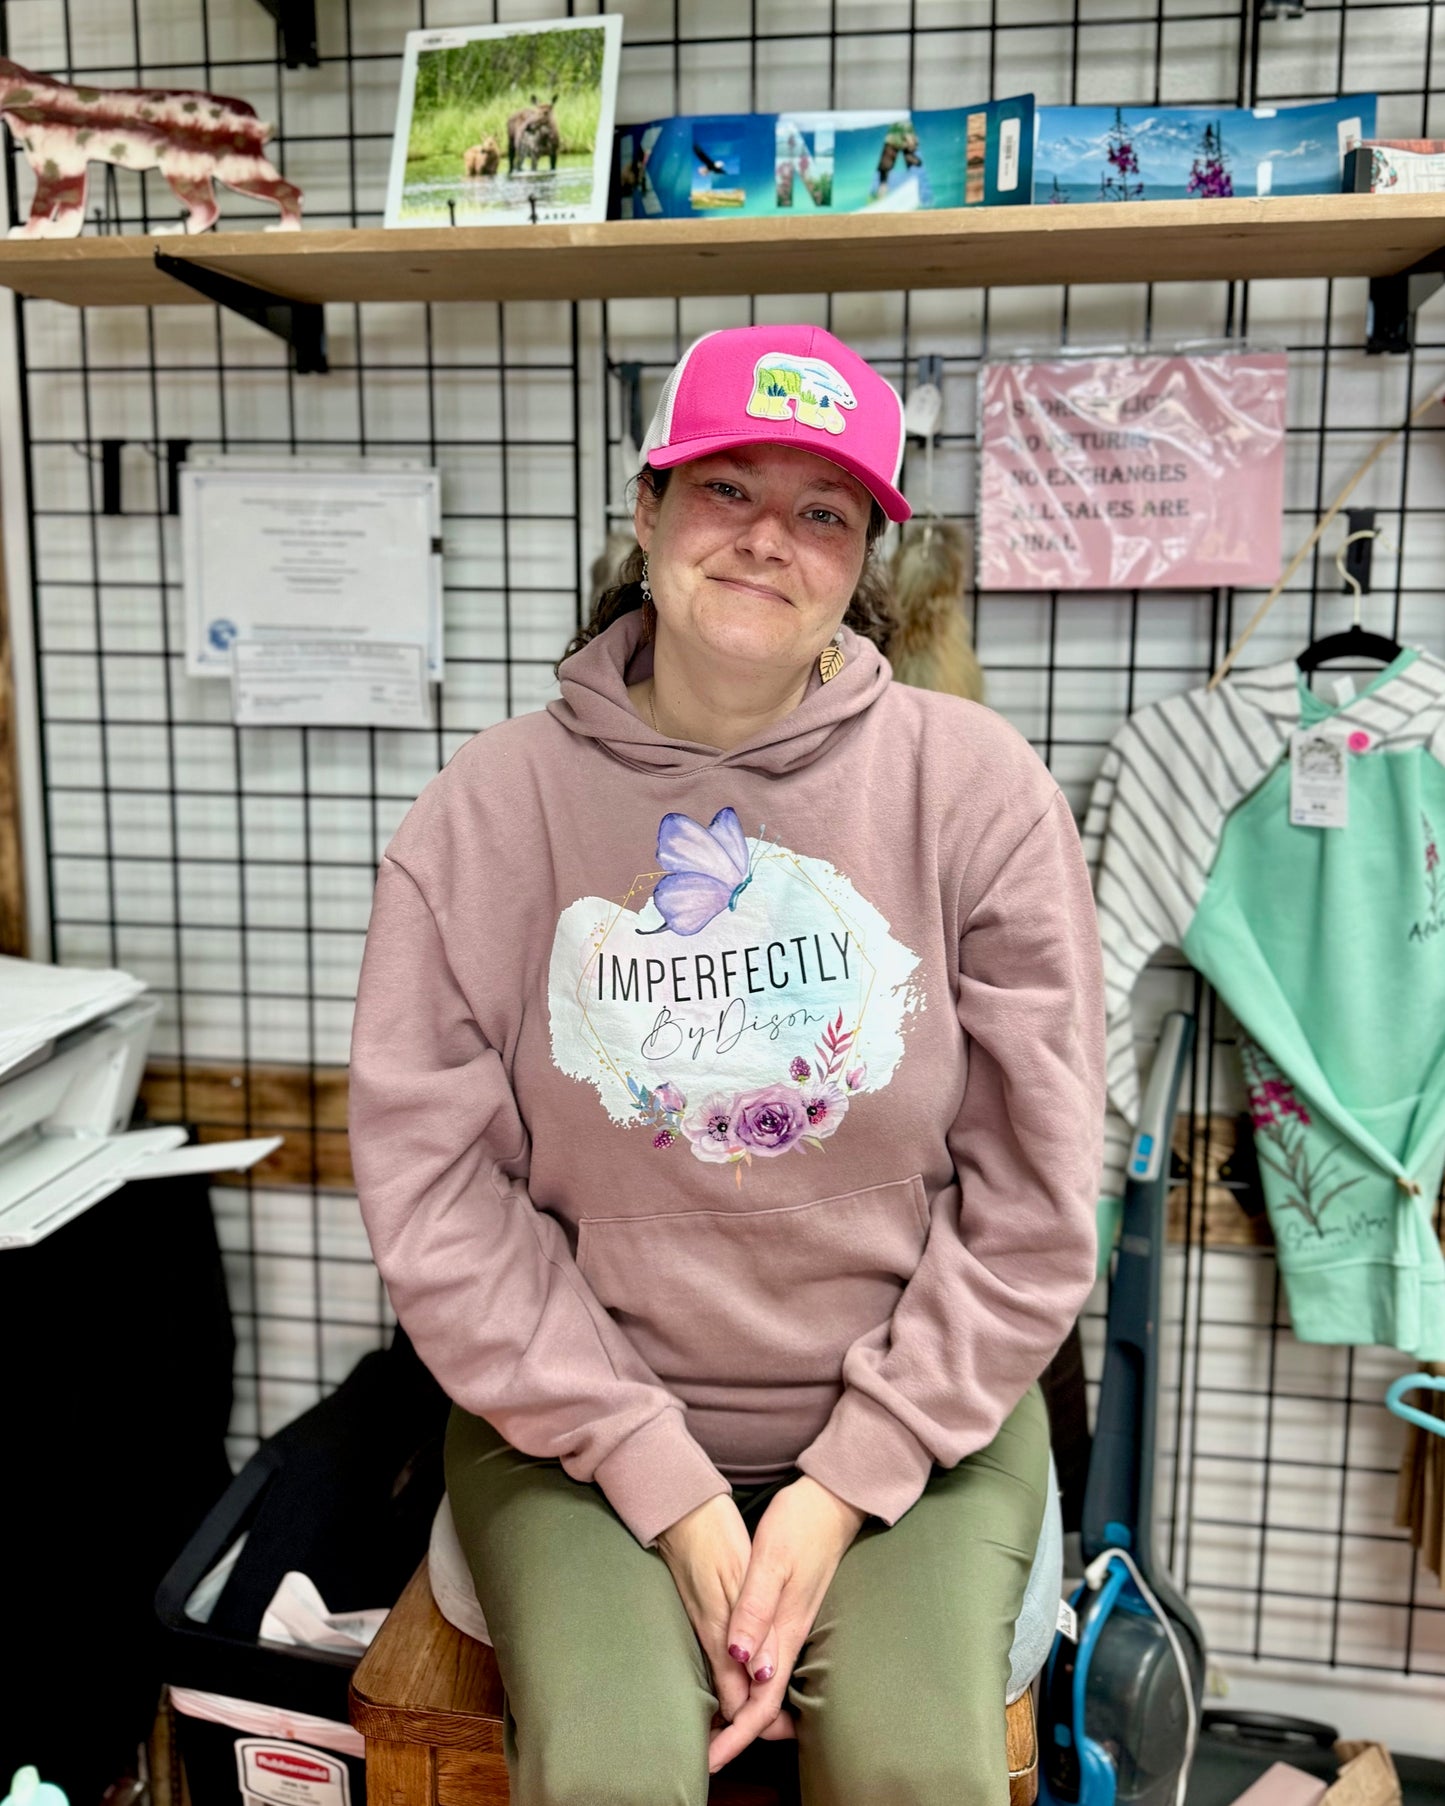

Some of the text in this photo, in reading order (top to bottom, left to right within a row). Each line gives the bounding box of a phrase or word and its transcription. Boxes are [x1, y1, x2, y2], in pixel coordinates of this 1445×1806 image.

[620, 112, 988, 218] KENAI
[1141, 499, 1190, 517] ARE
[598, 931, 851, 1002] IMPERFECTLY
